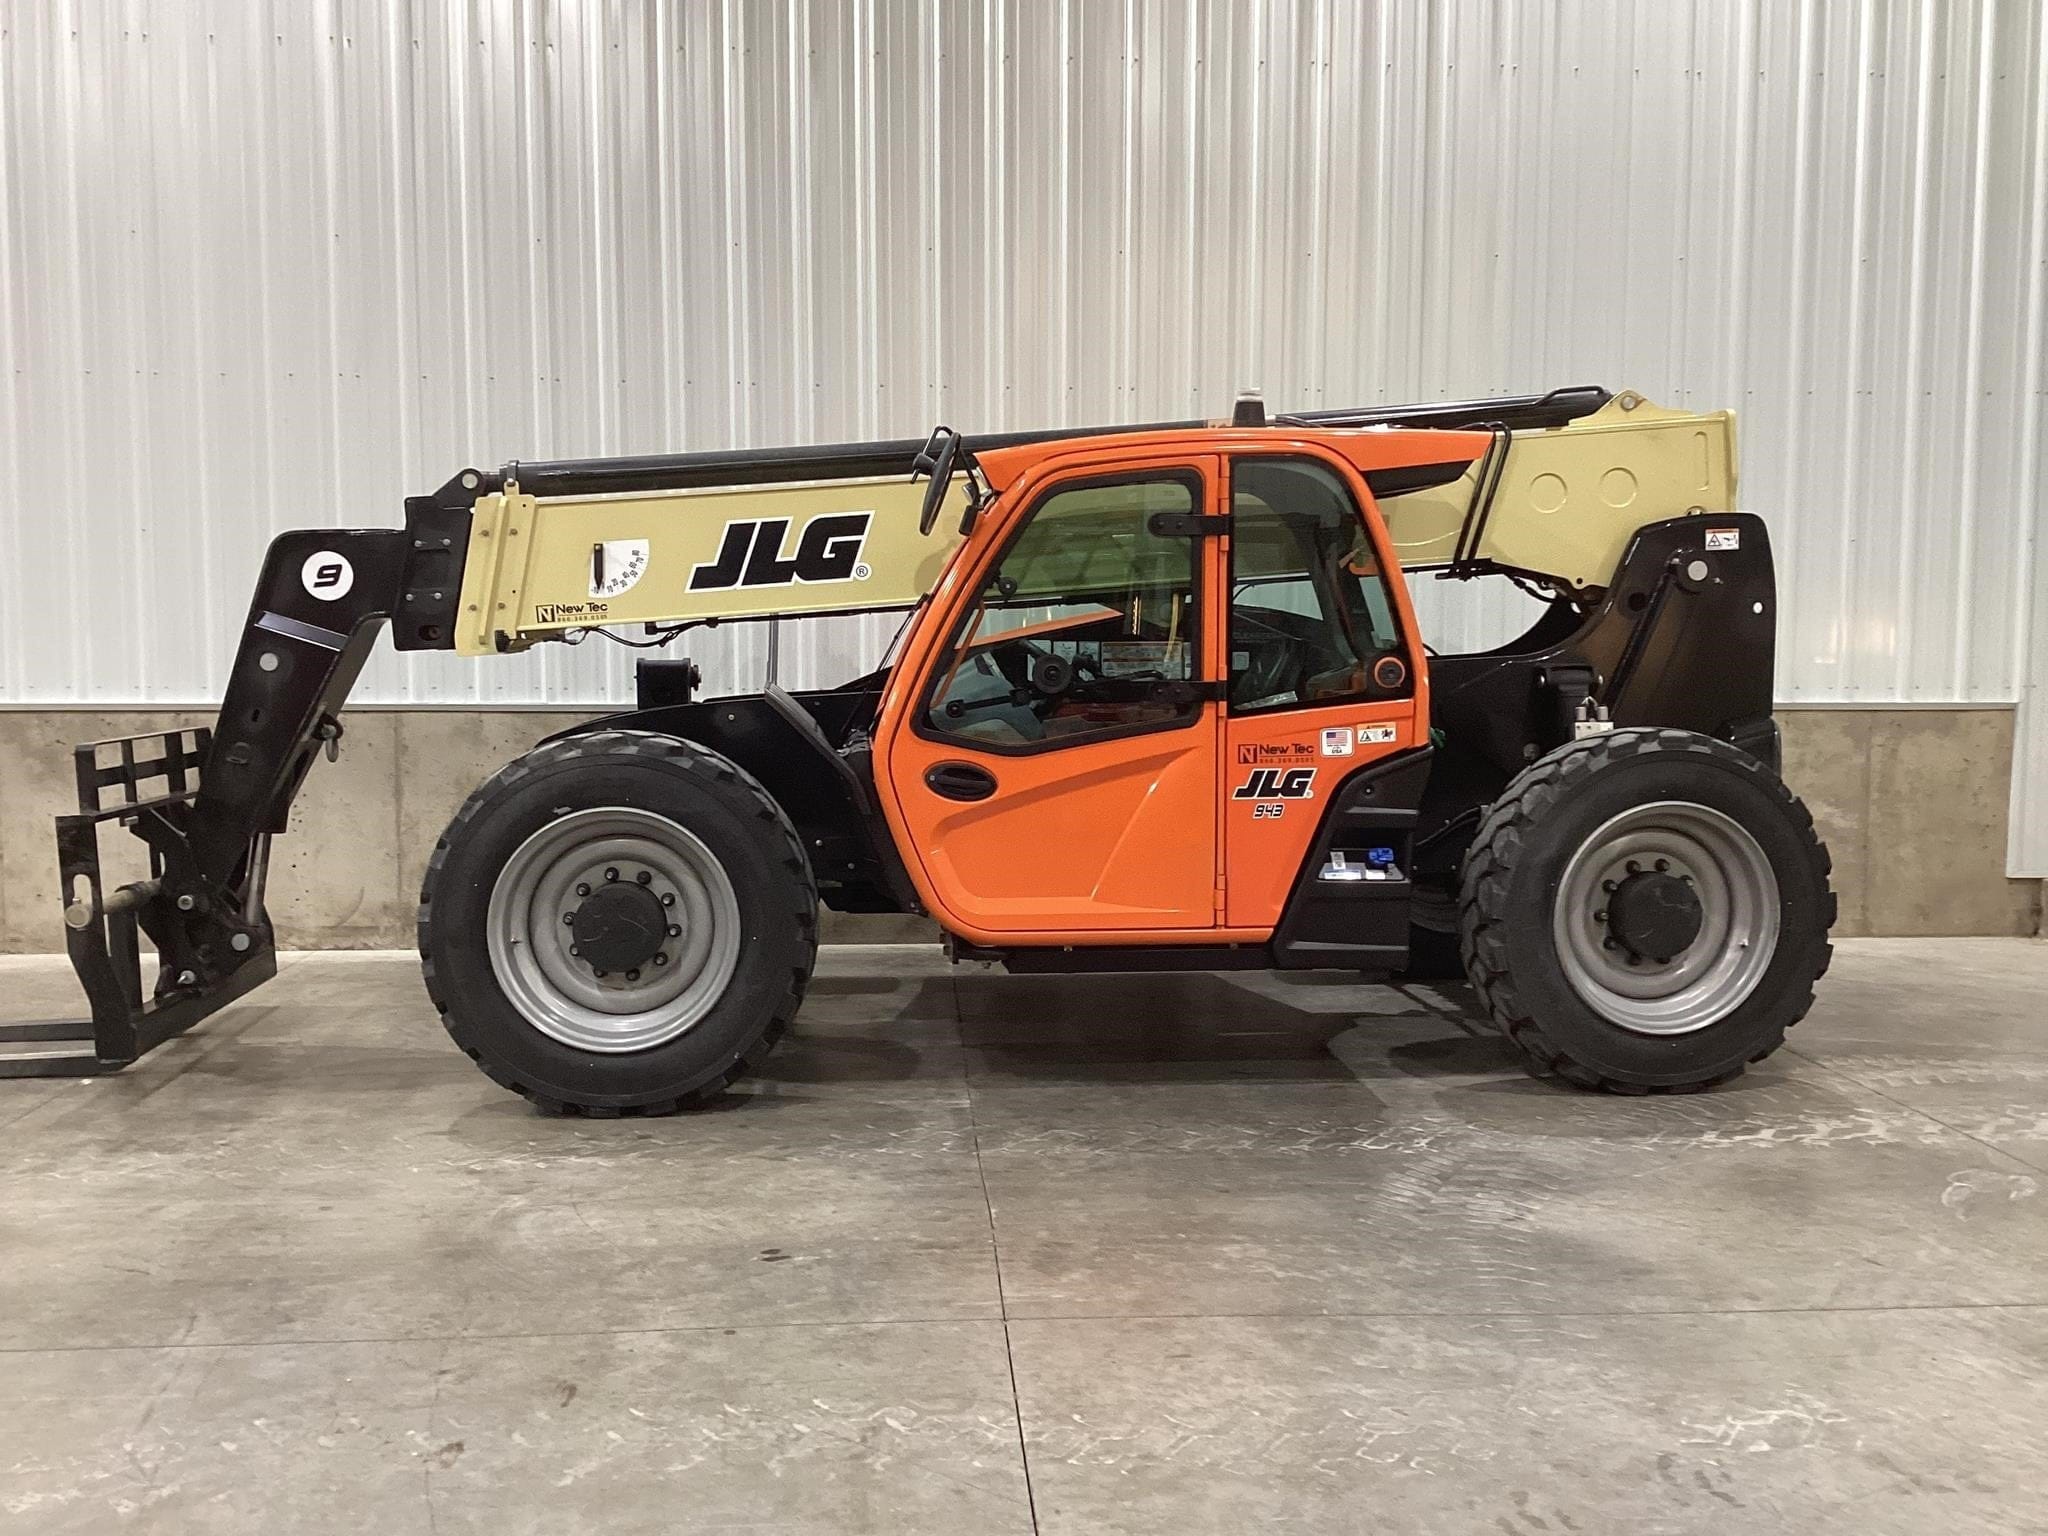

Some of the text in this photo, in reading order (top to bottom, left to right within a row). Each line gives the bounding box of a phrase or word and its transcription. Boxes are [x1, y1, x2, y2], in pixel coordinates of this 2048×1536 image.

[688, 513, 871, 591] JLG
[313, 563, 343, 589] 9
[555, 603, 584, 614] New
[585, 602, 608, 612] Tec
[1259, 744, 1289, 755] New
[1291, 743, 1315, 754] Tec
[1234, 769, 1315, 798] JLG
[1254, 804, 1284, 818] 943
